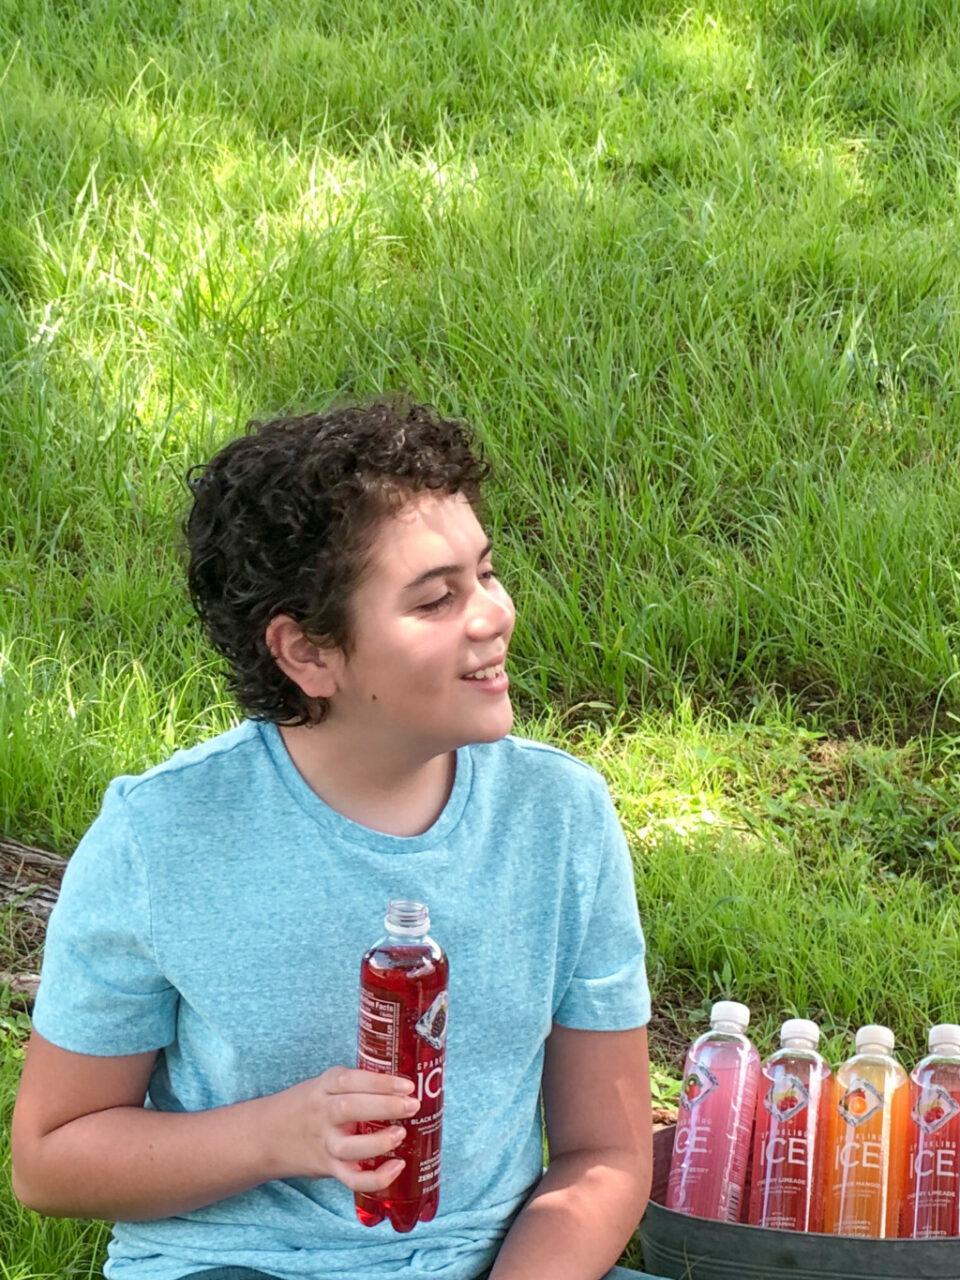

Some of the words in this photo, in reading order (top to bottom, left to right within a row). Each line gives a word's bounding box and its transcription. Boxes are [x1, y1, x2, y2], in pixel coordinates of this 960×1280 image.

[375, 1001, 394, 1011] Facts
[386, 1024, 394, 1034] 5
[416, 1055, 444, 1070] SPARK
[416, 1066, 442, 1102] IC
[410, 1115, 432, 1125] BLACK
[760, 1137, 807, 1166] ICE
[835, 1141, 882, 1170] ICE
[910, 1149, 956, 1179] ICE
[417, 1171, 434, 1183] ZERO
[778, 1177, 806, 1186] LIMEADE
[928, 1190, 956, 1198] LIMEADE
